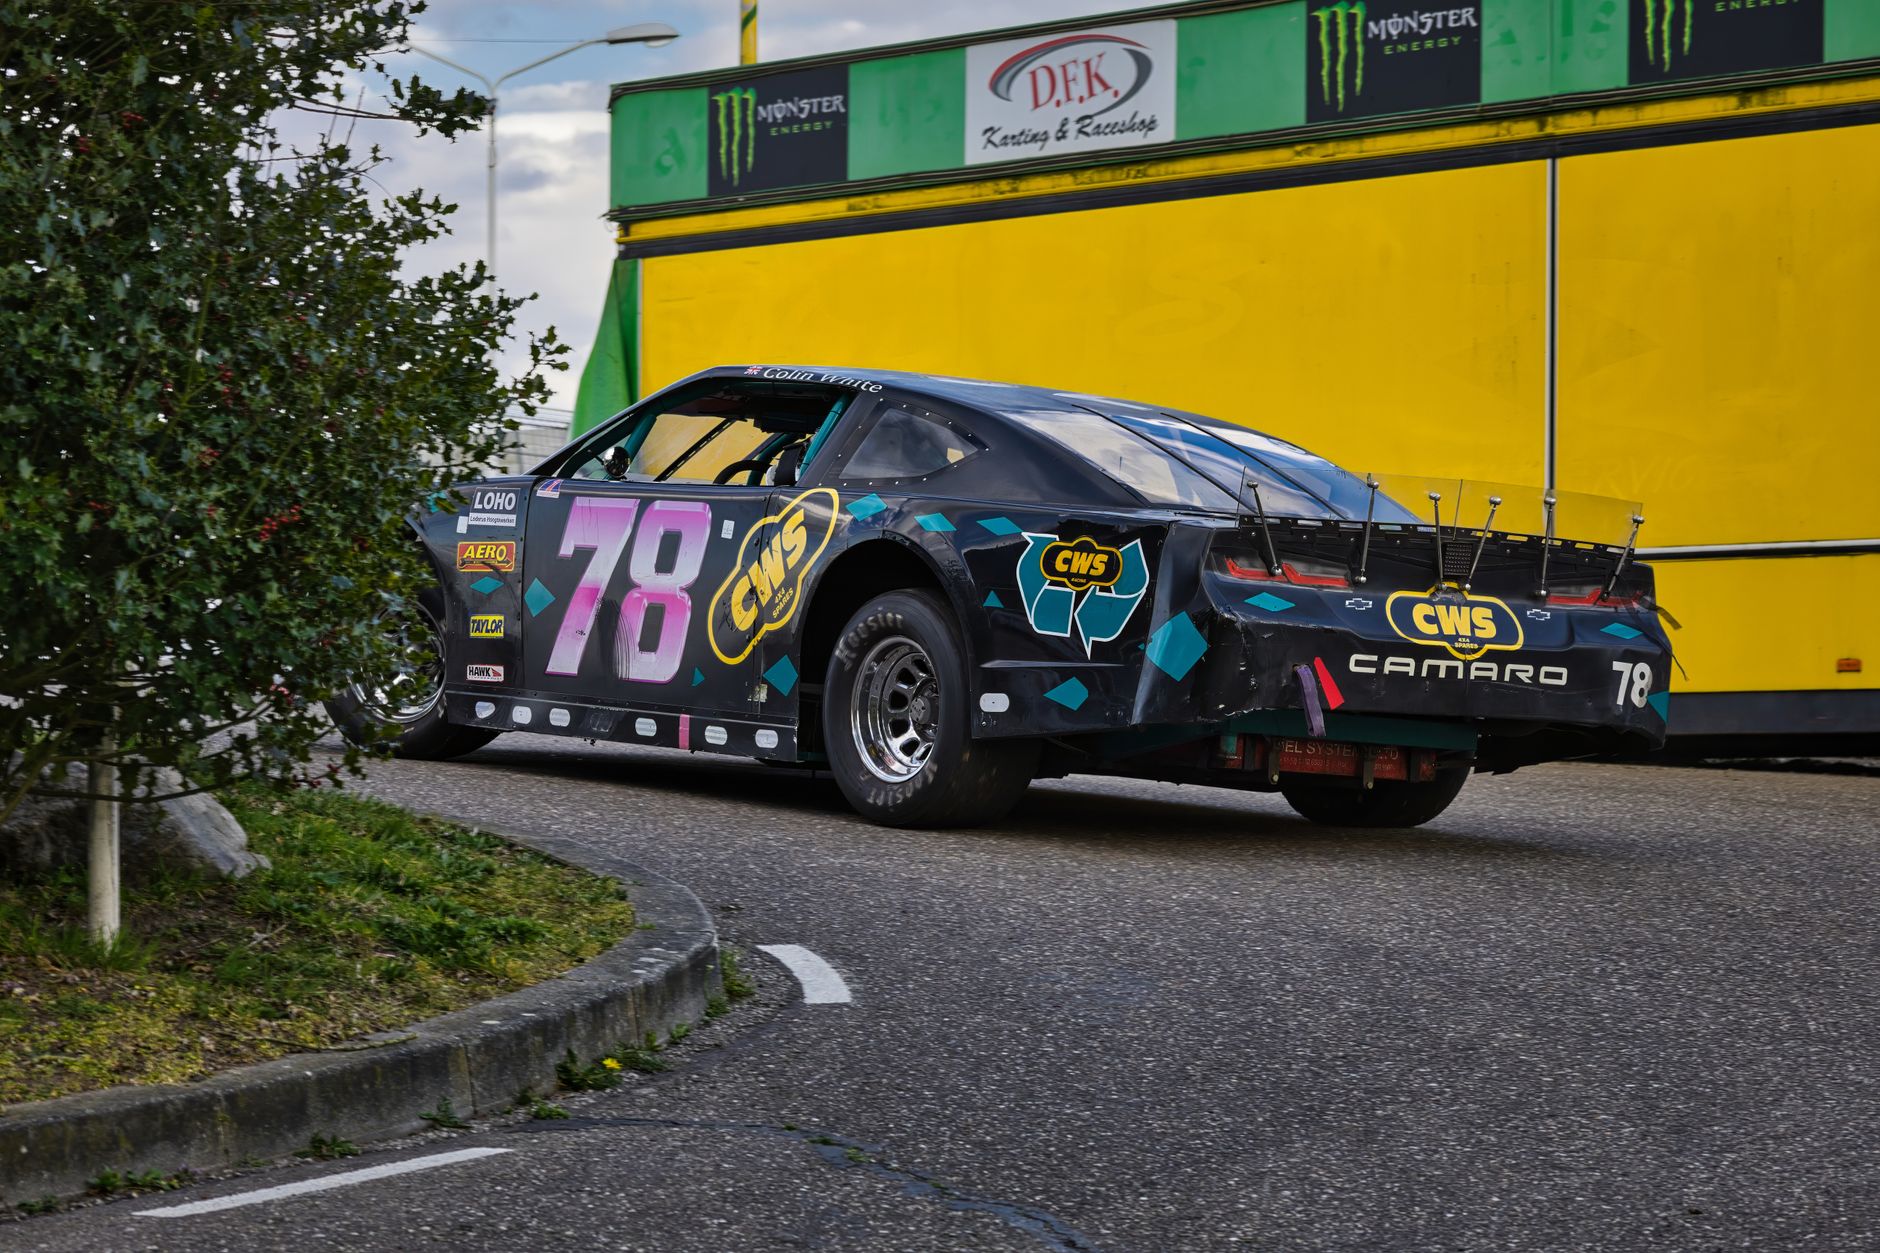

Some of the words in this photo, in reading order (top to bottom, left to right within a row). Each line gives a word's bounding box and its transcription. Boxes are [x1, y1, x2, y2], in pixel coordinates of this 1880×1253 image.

[1713, 0, 1800, 12] ENERG
[1367, 7, 1478, 40] MONSTER
[1383, 36, 1461, 55] ENERGY
[1027, 52, 1120, 111] D.F.K.
[757, 95, 846, 123] MONSTER
[769, 121, 832, 136] ENERGY
[982, 126, 1050, 151] Karting
[1055, 117, 1070, 141] &
[1074, 111, 1159, 139] Raceshop
[763, 368, 816, 381] Colin
[820, 373, 883, 393] White
[474, 492, 517, 511] LOHO
[463, 545, 507, 562] AERO
[1055, 549, 1109, 576] CWS
[731, 508, 807, 631] CWS
[544, 496, 712, 684] 78
[772, 587, 794, 619] SPARES
[471, 619, 503, 634] TAYLOR
[1412, 602, 1497, 639] CWS
[468, 666, 491, 677] HAWK
[1349, 653, 1568, 686] CAMARO
[1612, 661, 1653, 708] 78
